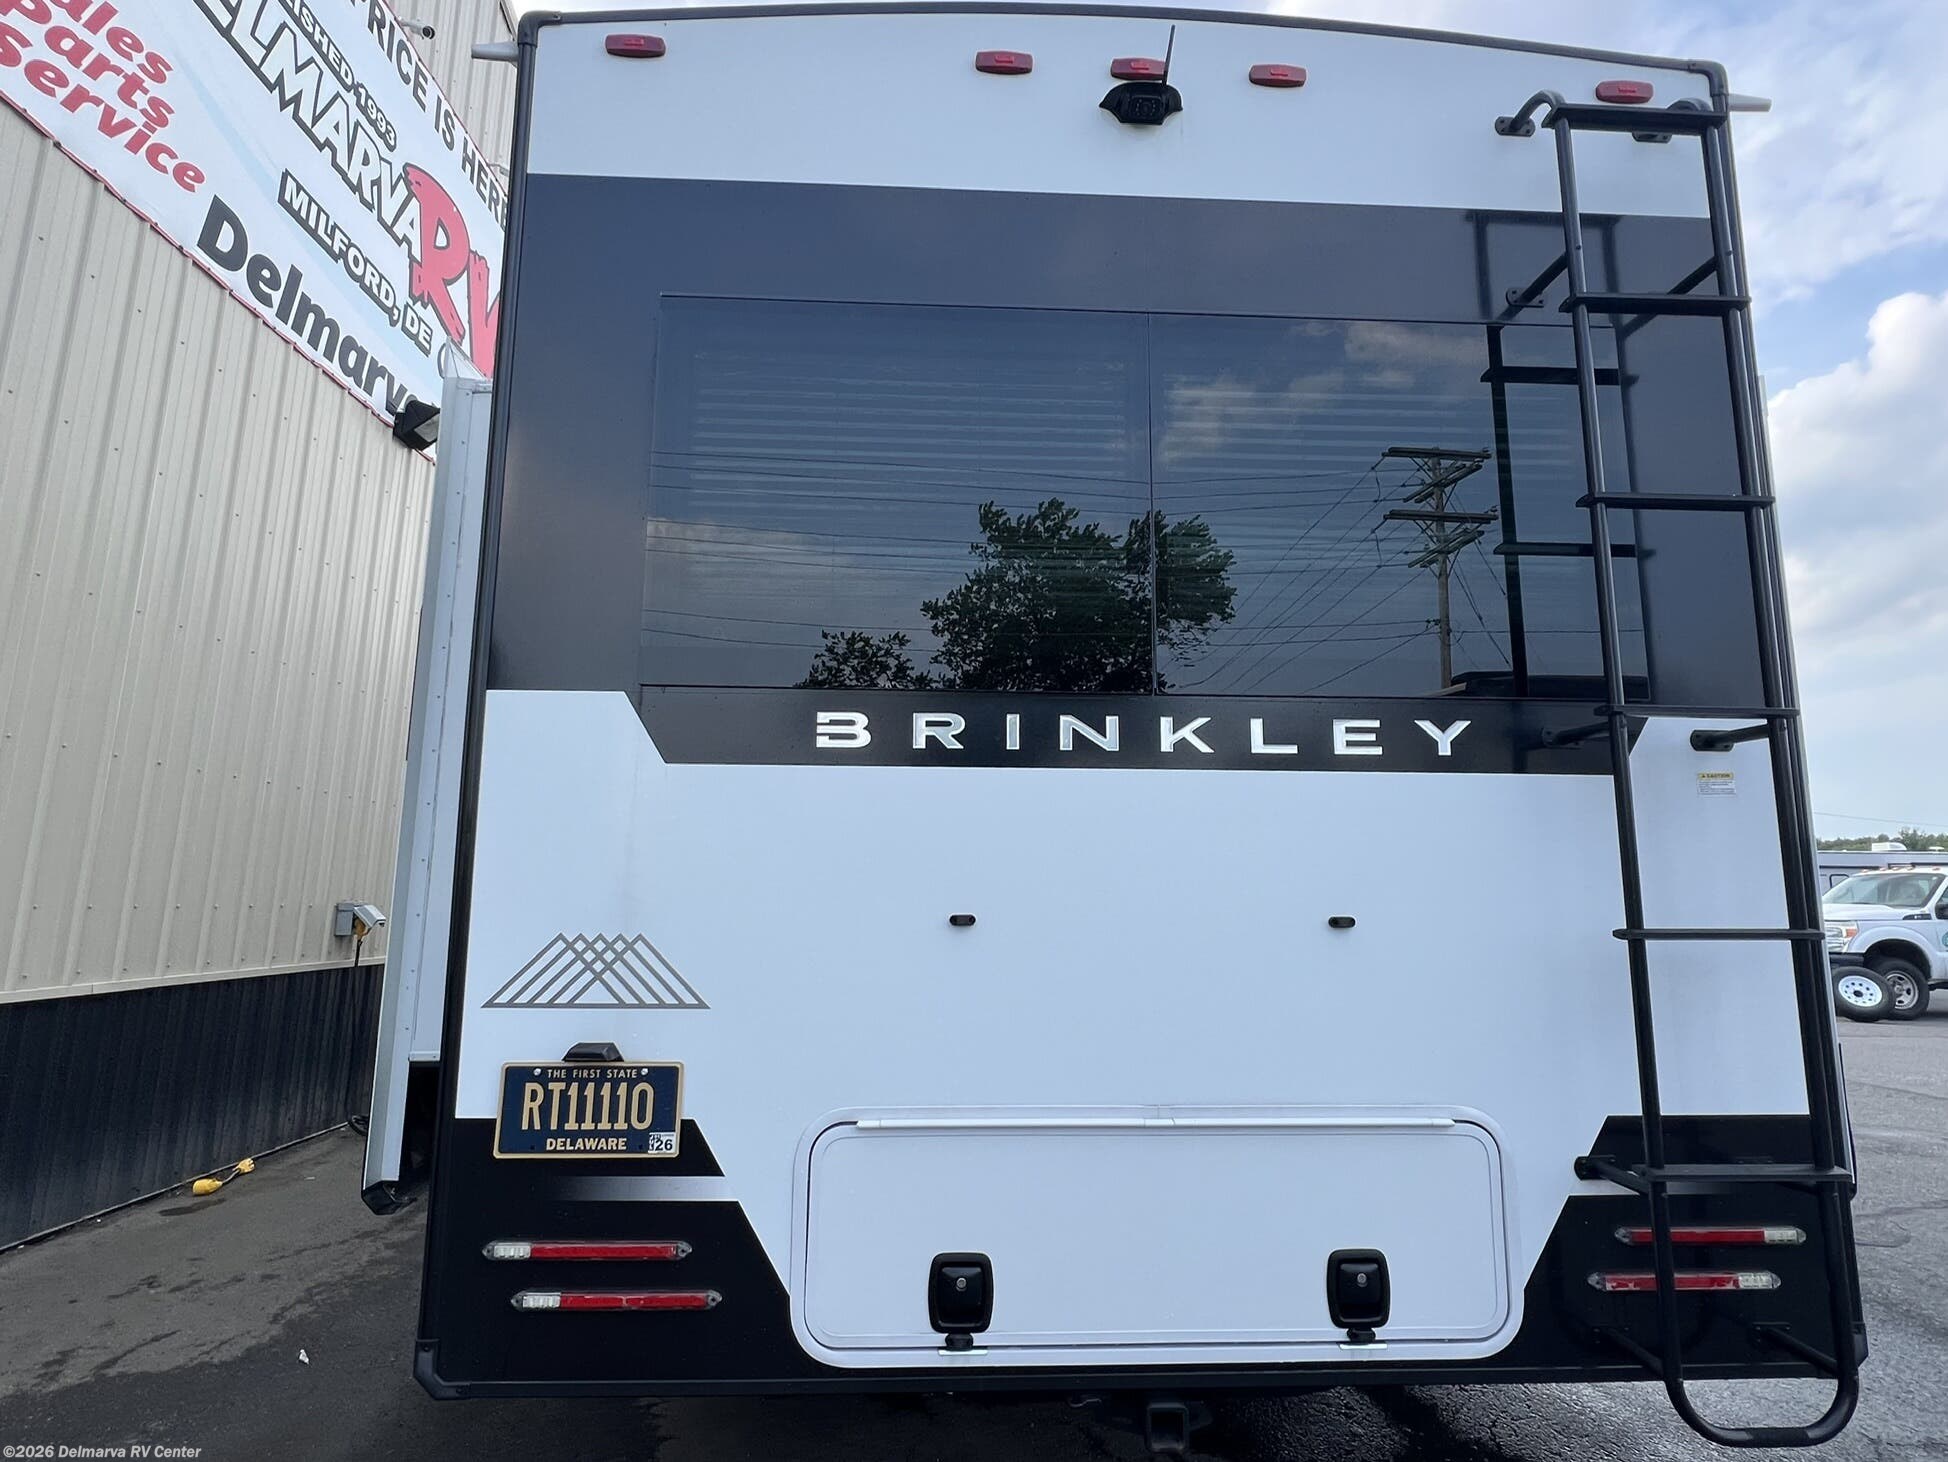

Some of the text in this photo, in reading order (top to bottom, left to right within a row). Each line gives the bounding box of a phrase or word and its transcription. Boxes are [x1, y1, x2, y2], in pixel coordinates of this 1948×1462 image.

[52, 0, 173, 84] ales
[281, 0, 397, 152] ISHED 1993
[351, 0, 428, 112] RICE
[434, 95, 455, 151] IS
[278, 168, 433, 357] MILFORD, DE
[198, 195, 418, 417] Delmarv
[815, 712, 1471, 755] BRINKLEY
[521, 1082, 655, 1131] RT11110
[547, 1069, 637, 1079] THE FIRST STATE
[546, 1137, 627, 1151] DELAWARE
[655, 1139, 673, 1151] 26
